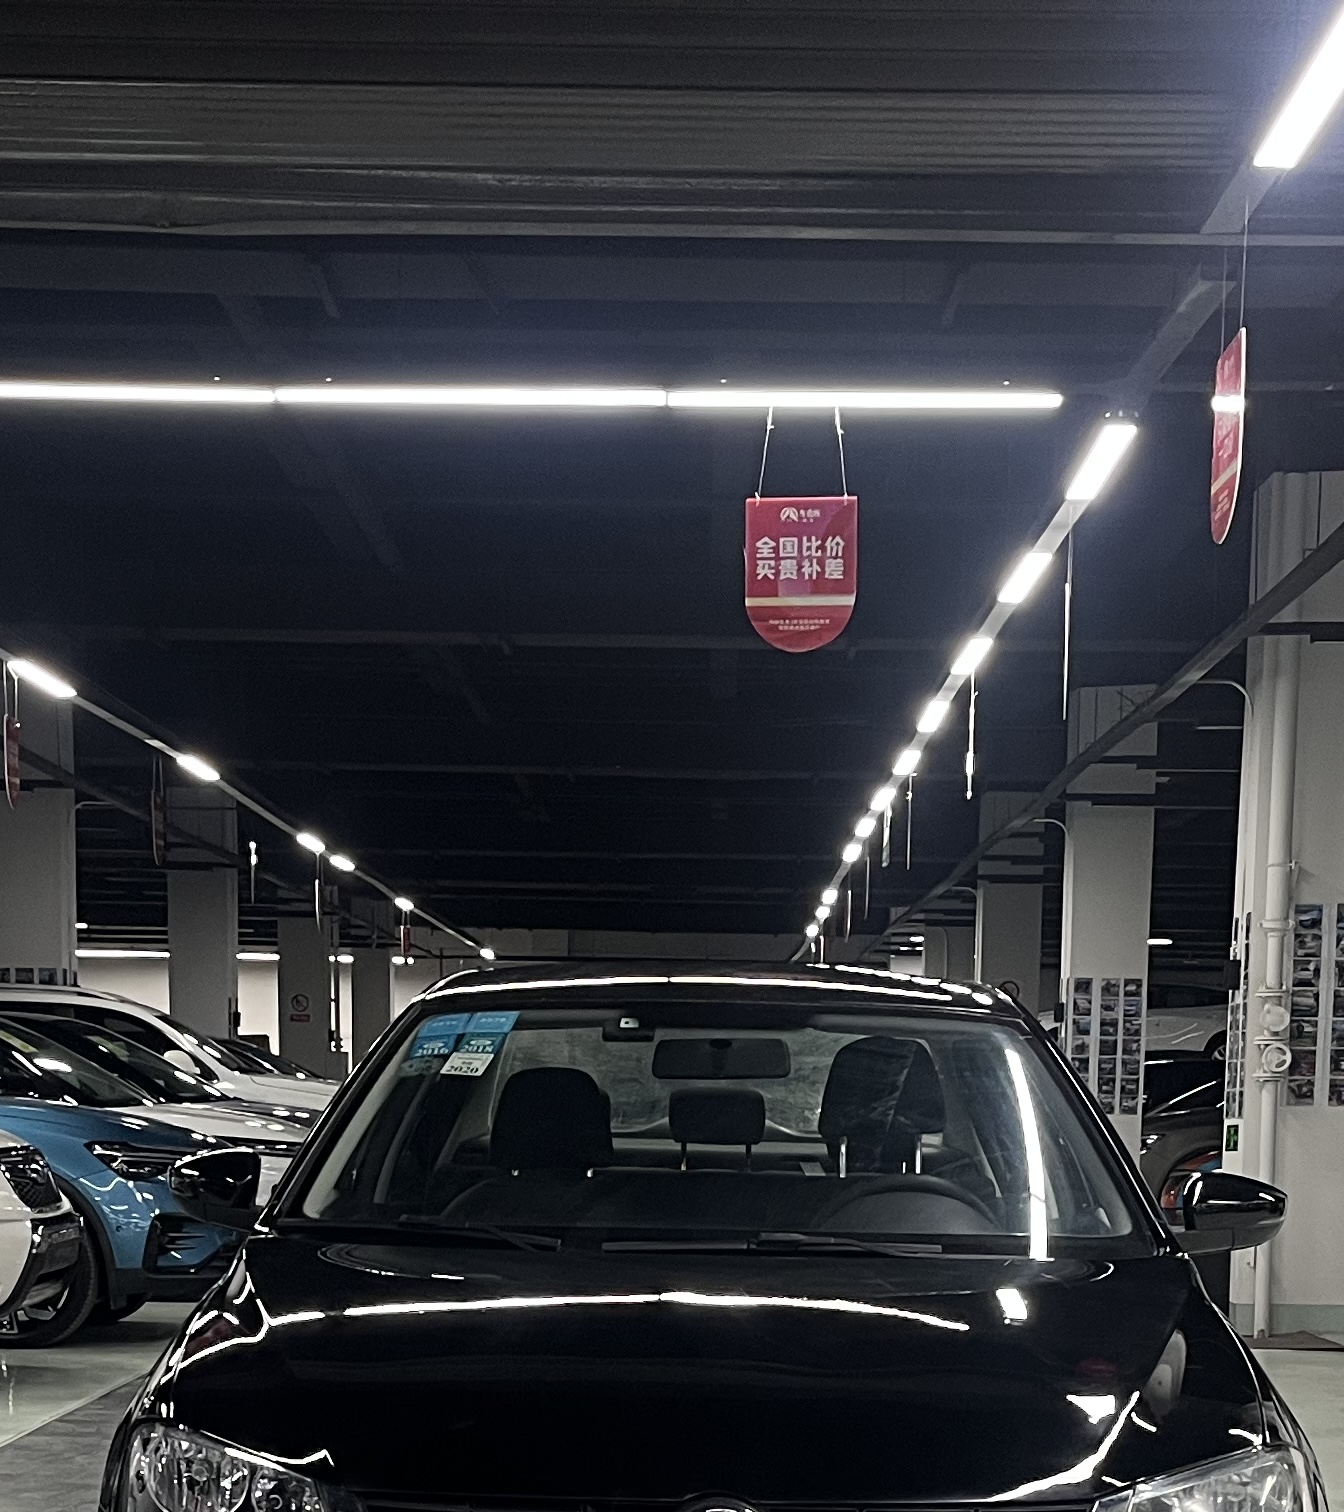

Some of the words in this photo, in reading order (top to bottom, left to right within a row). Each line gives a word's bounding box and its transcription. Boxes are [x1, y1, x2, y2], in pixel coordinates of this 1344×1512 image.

[755, 536, 845, 558] 全国比价
[756, 559, 844, 580] 买贵补差
[446, 1065, 479, 1074] 2020
